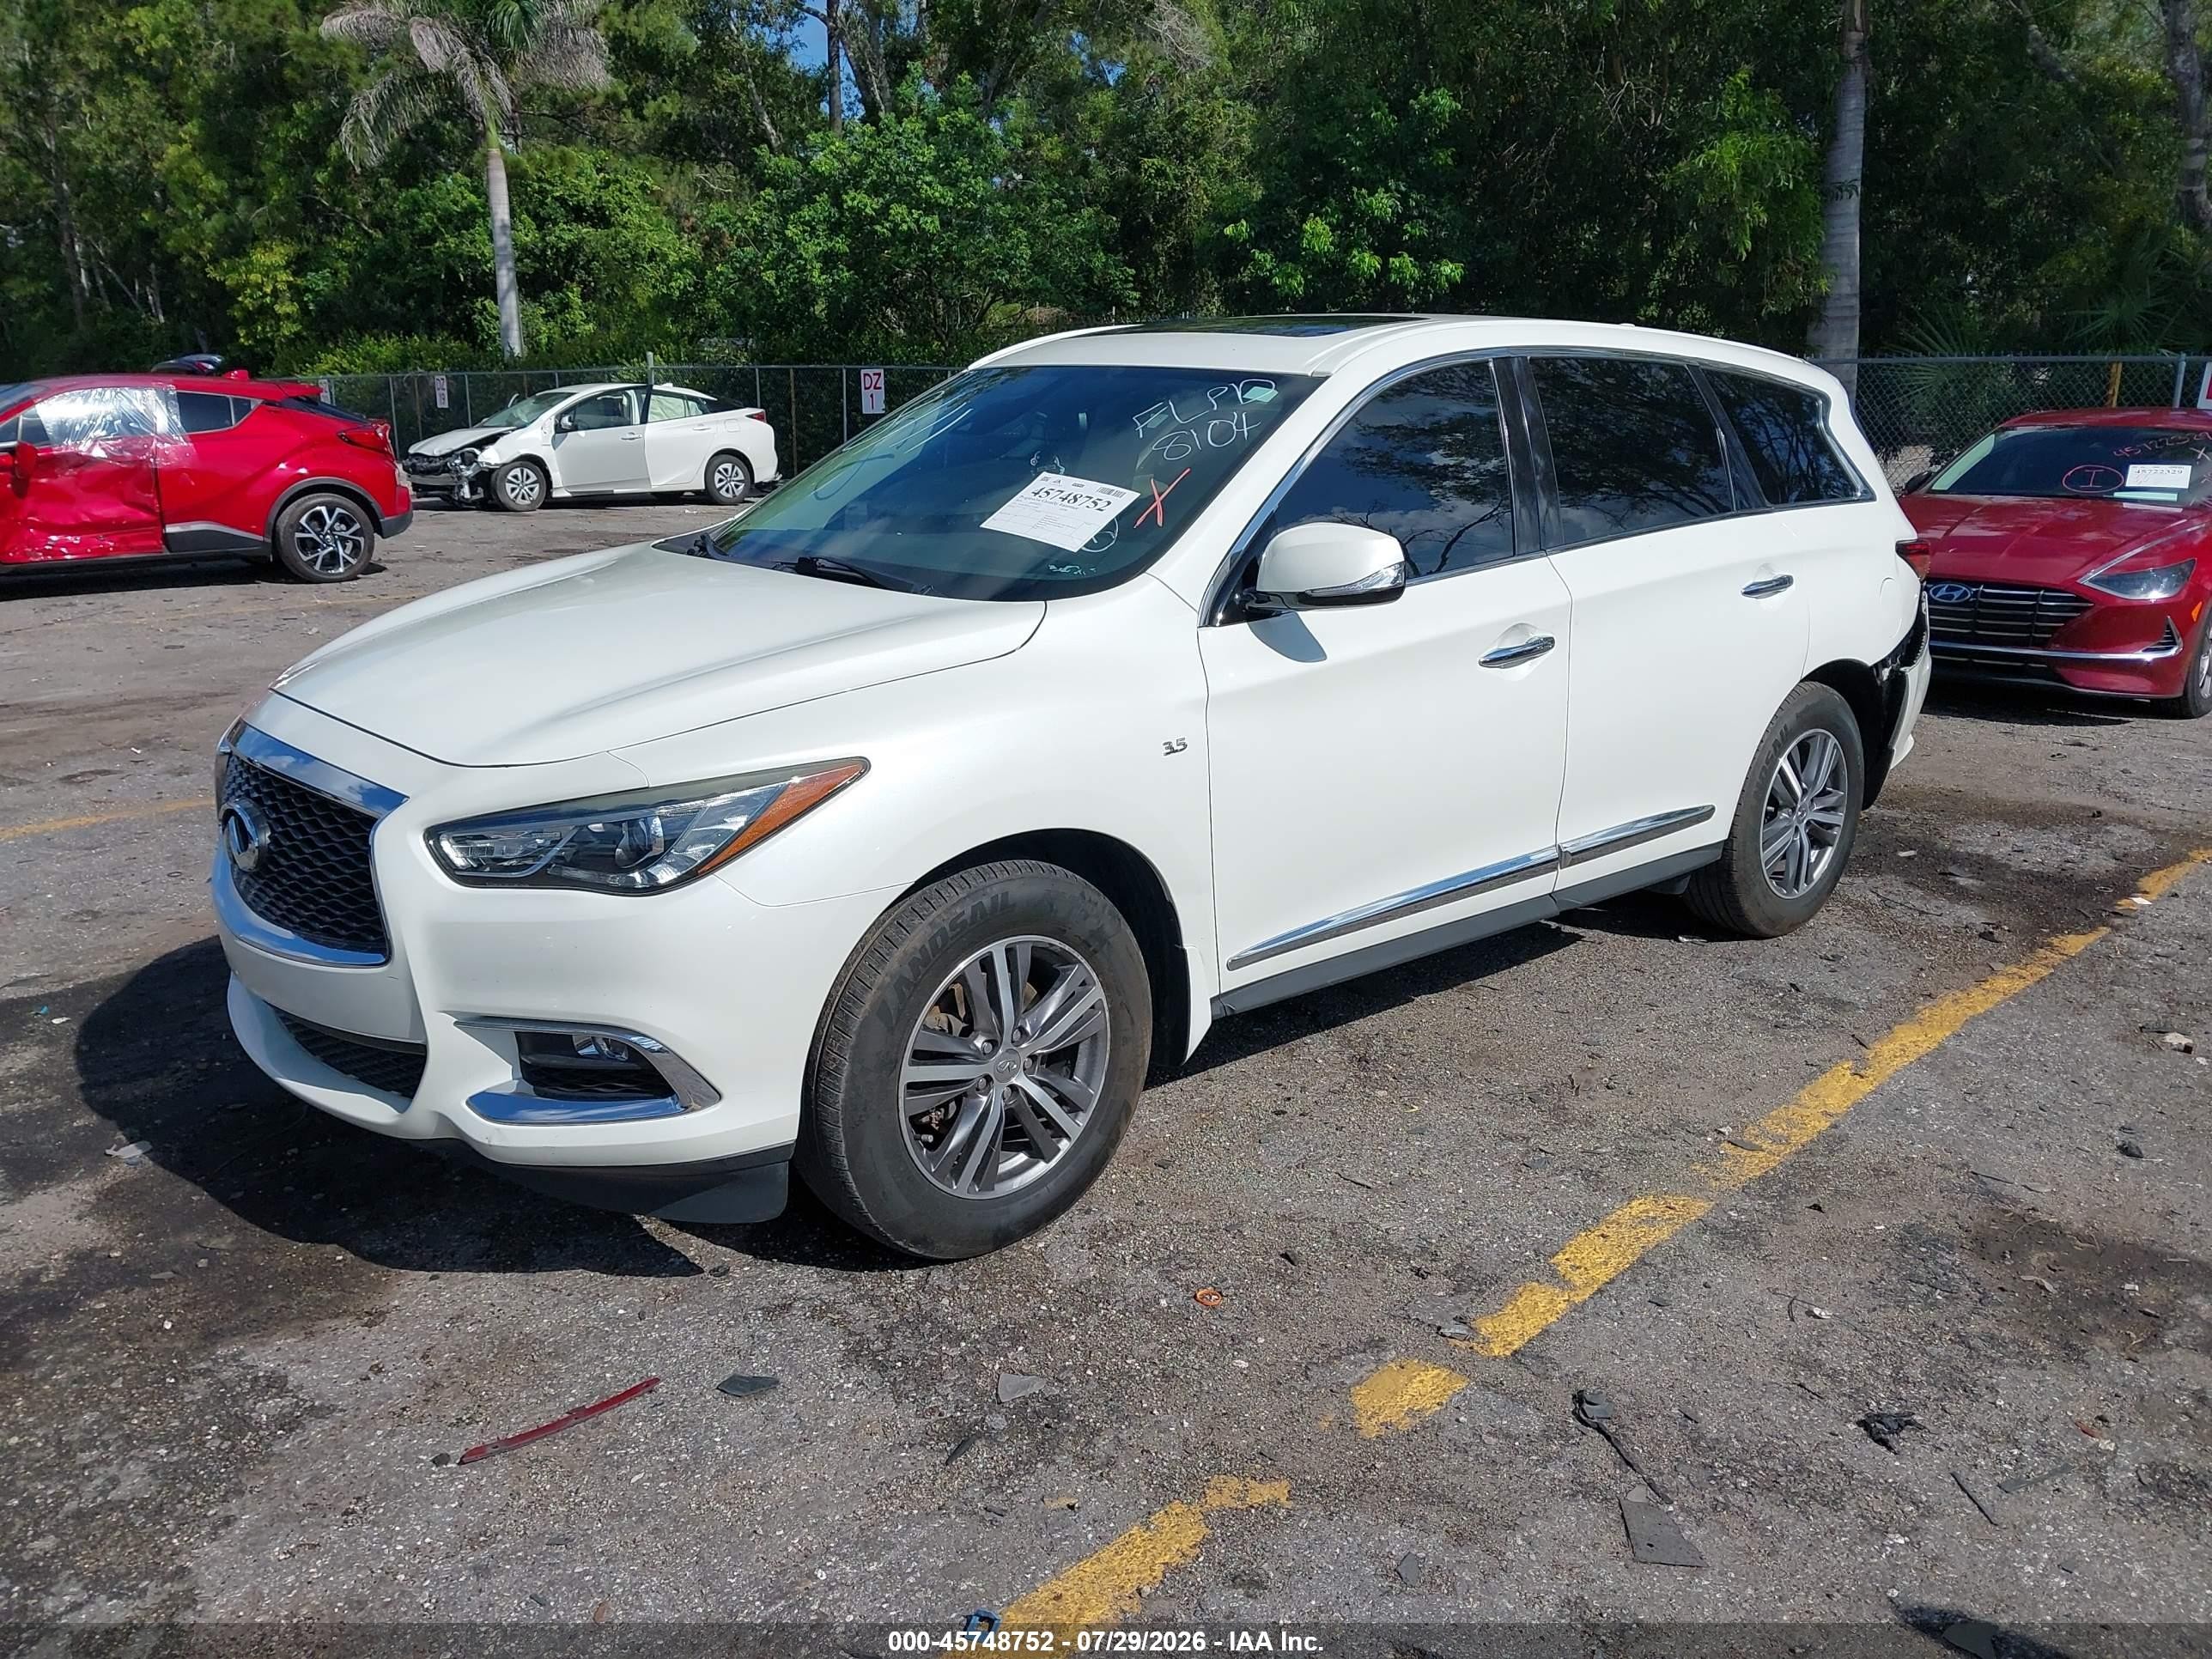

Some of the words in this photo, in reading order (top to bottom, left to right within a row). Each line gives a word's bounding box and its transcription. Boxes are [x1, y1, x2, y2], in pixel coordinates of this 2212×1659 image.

[863, 372, 882, 391] DZ
[869, 393, 875, 410] 1
[1152, 411, 1261, 460] 8104
[1031, 487, 1112, 512] 45748752
